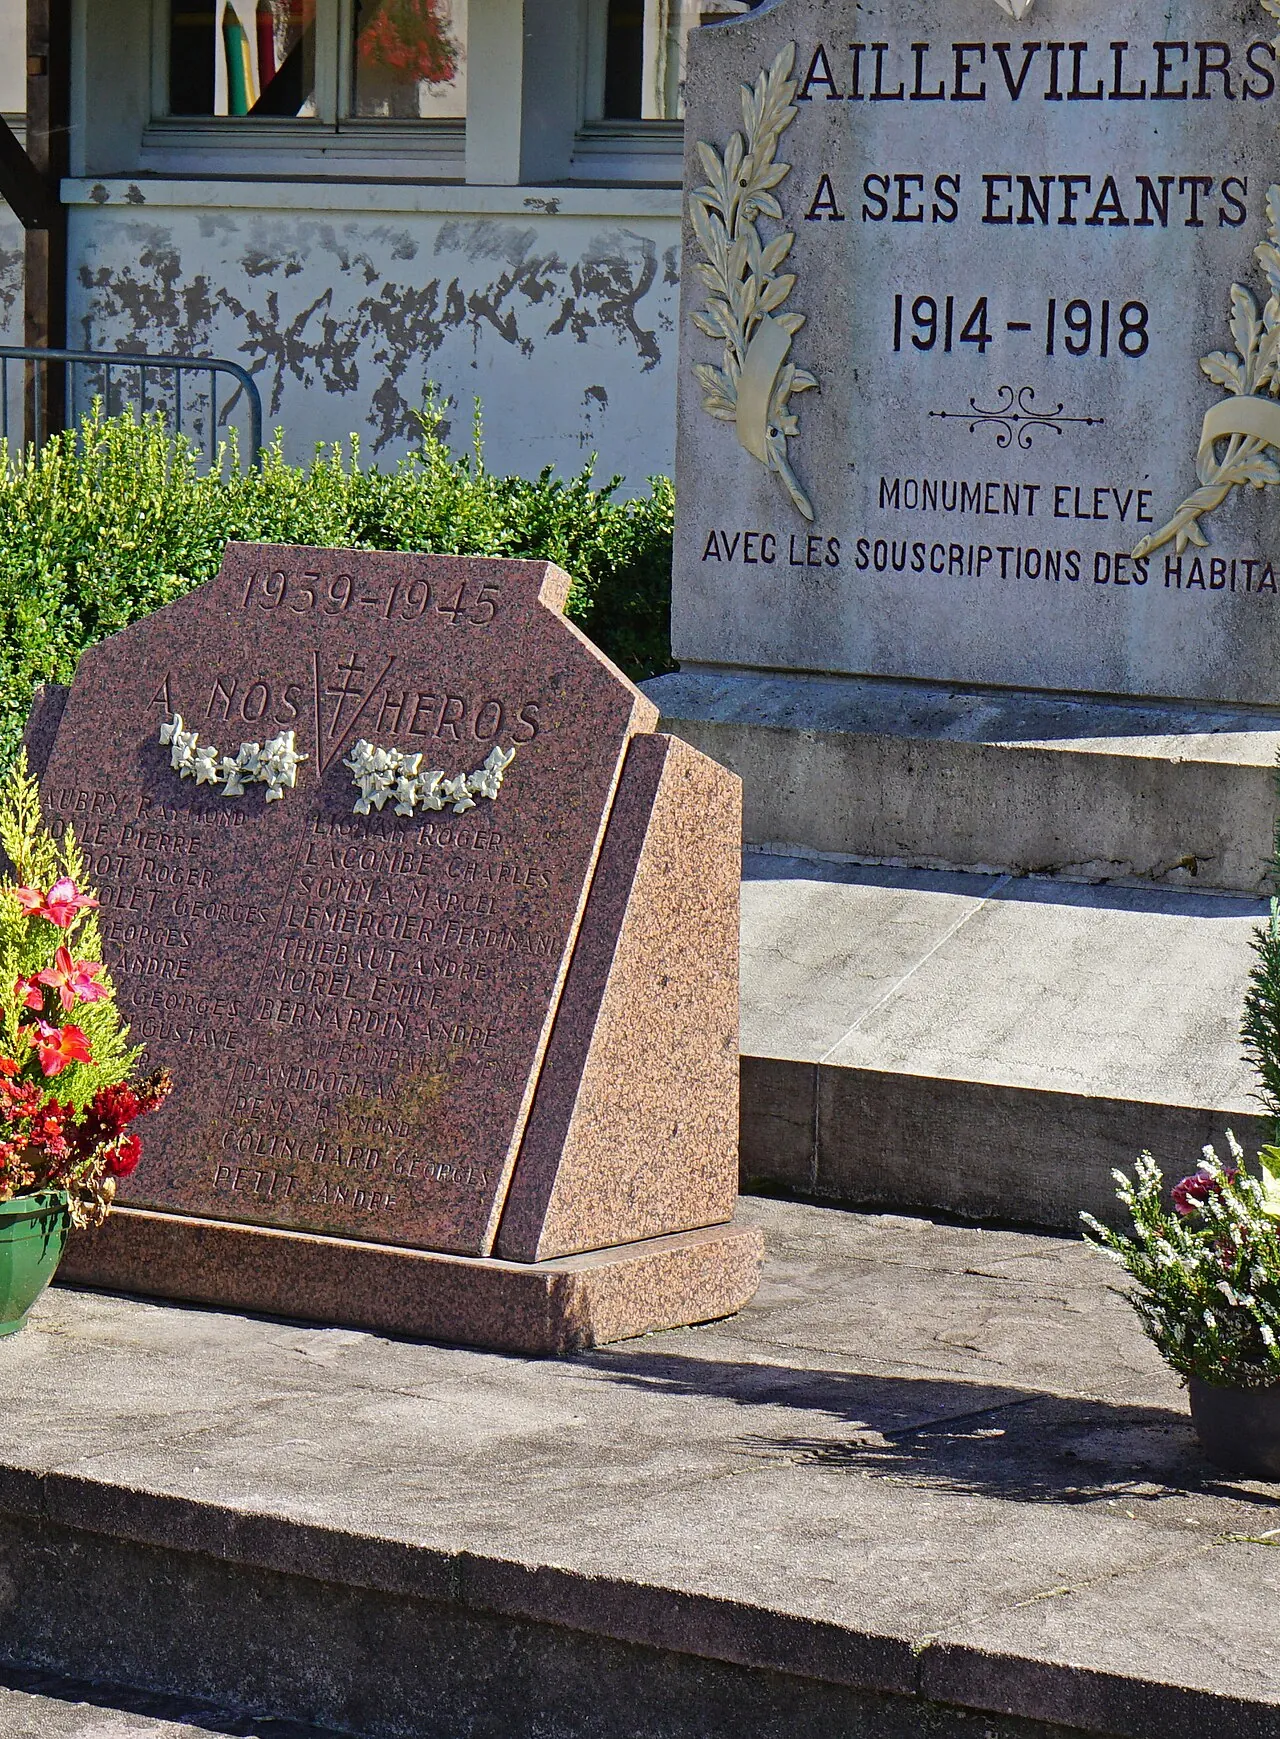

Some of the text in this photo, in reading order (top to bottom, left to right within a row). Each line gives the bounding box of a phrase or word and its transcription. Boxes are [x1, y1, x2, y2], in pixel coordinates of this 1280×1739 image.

[800, 40, 1277, 102] AILLEVILLERS
[804, 173, 1247, 228] A SES ENFANTS
[893, 295, 1150, 359] 1914-1918
[879, 475, 1153, 524] MONUMENT ELEVÉ
[701, 530, 775, 565] AVEC
[788, 535, 840, 568] LES
[855, 540, 1081, 584] SOUSCRIPTIONS
[1094, 550, 1149, 587] DES
[242, 568, 500, 627] 1939-1945
[146, 671, 540, 746] A NOS HEROS
[44, 789, 247, 828] AUBRY RAYMOND
[120, 825, 201, 856] PIERRE
[417, 823, 502, 851] ROGER
[139, 857, 214, 889] ROGER
[304, 843, 553, 888] LACOMBE CHARLES
[172, 892, 270, 925] GEORGES
[408, 884, 498, 915] MARCEL
[286, 905, 435, 943] LEMERCIER
[116, 951, 192, 980] ANDRE
[279, 937, 488, 982] THIEBAUT ANDRE
[131, 984, 241, 1018] GEORGES
[270, 966, 358, 1000] MOREL
[141, 1016, 238, 1050] GUSTAVE
[257, 999, 497, 1049] BERNARDIN ANDRE
[314, 1106, 411, 1138] RAYMOND
[222, 1131, 494, 1187] COLINCHARD GEORGES
[213, 1165, 397, 1212] PETIT ANDRE
